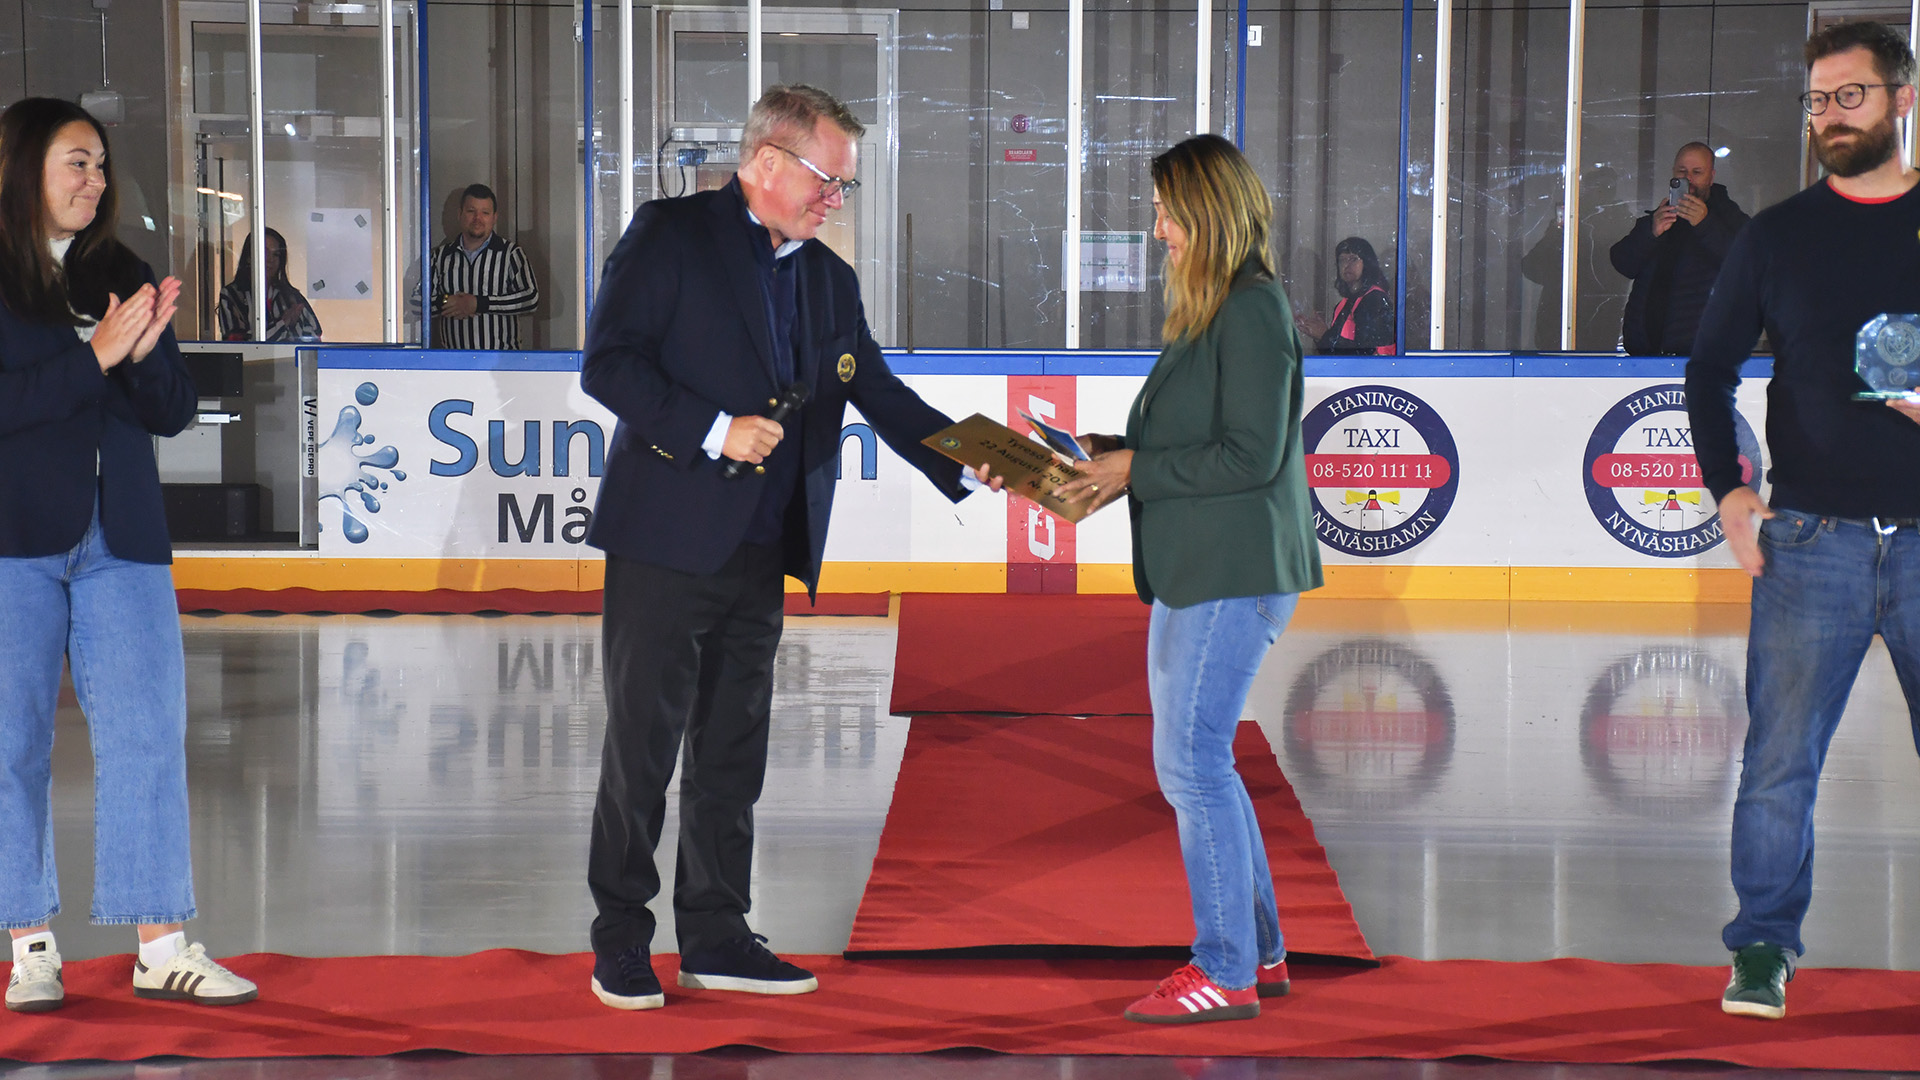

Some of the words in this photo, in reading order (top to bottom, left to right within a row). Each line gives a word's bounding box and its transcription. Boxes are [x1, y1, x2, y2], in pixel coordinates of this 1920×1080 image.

[1327, 391, 1419, 418] HANINGE
[1626, 390, 1687, 416] HANI
[1343, 428, 1401, 448] TAXI
[1643, 427, 1694, 447] TAX
[307, 444, 315, 476] ICEPRO
[980, 439, 997, 450] 22
[996, 448, 1043, 475] Augusti
[1042, 472, 1068, 487] 202
[1313, 463, 1375, 478] 08-520
[1380, 463, 1407, 478] 111
[1415, 463, 1432, 478] 11
[1610, 462, 1674, 478] 08-520
[1680, 463, 1703, 478] 11
[1312, 510, 1437, 552] NYNÄSHAMN
[1605, 511, 1724, 552] NYNÄSHAM
